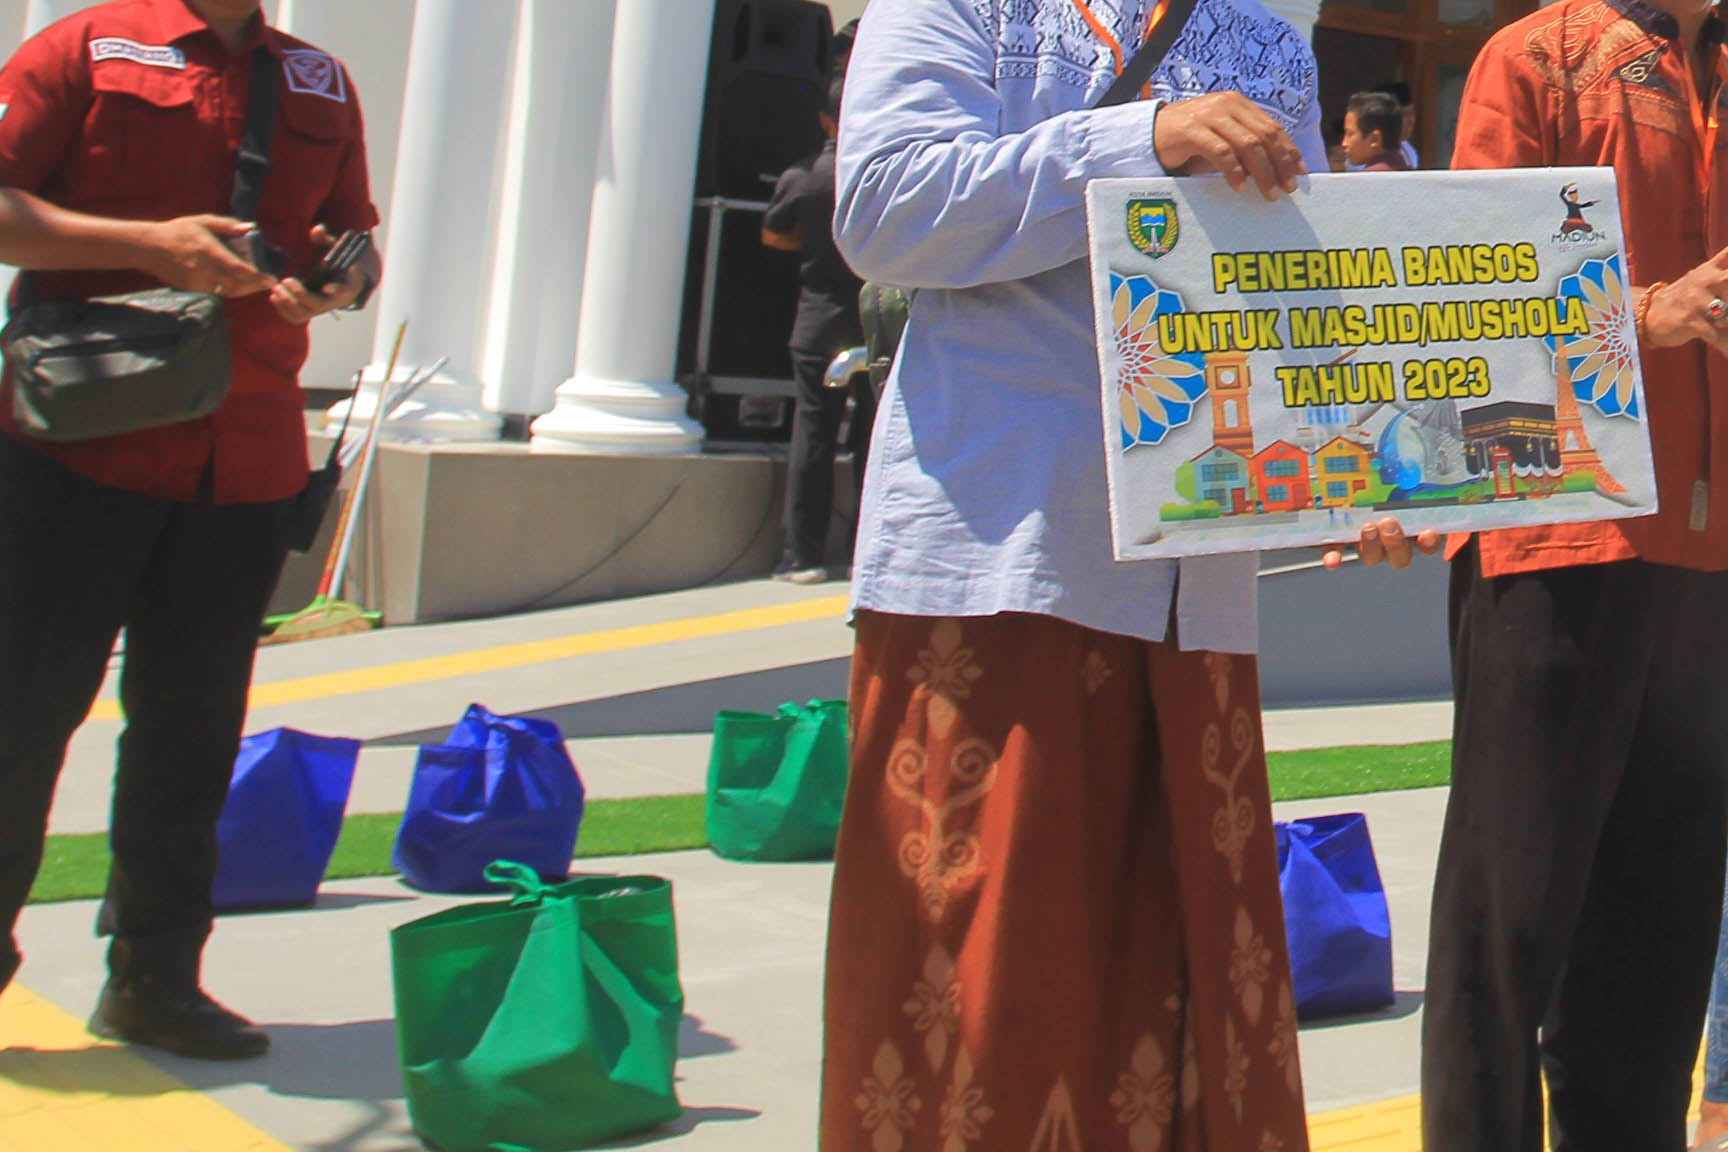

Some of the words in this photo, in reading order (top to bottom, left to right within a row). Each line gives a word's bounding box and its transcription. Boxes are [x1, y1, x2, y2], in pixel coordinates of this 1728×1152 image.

[1212, 248, 1397, 293] PENERIMA
[1402, 243, 1538, 286] BANSOS
[1157, 308, 1283, 354] UNTUK
[1288, 297, 1589, 347] MASJID/MUSHOLA
[1275, 361, 1395, 407] TAHUN
[1403, 356, 1491, 400] 2023
